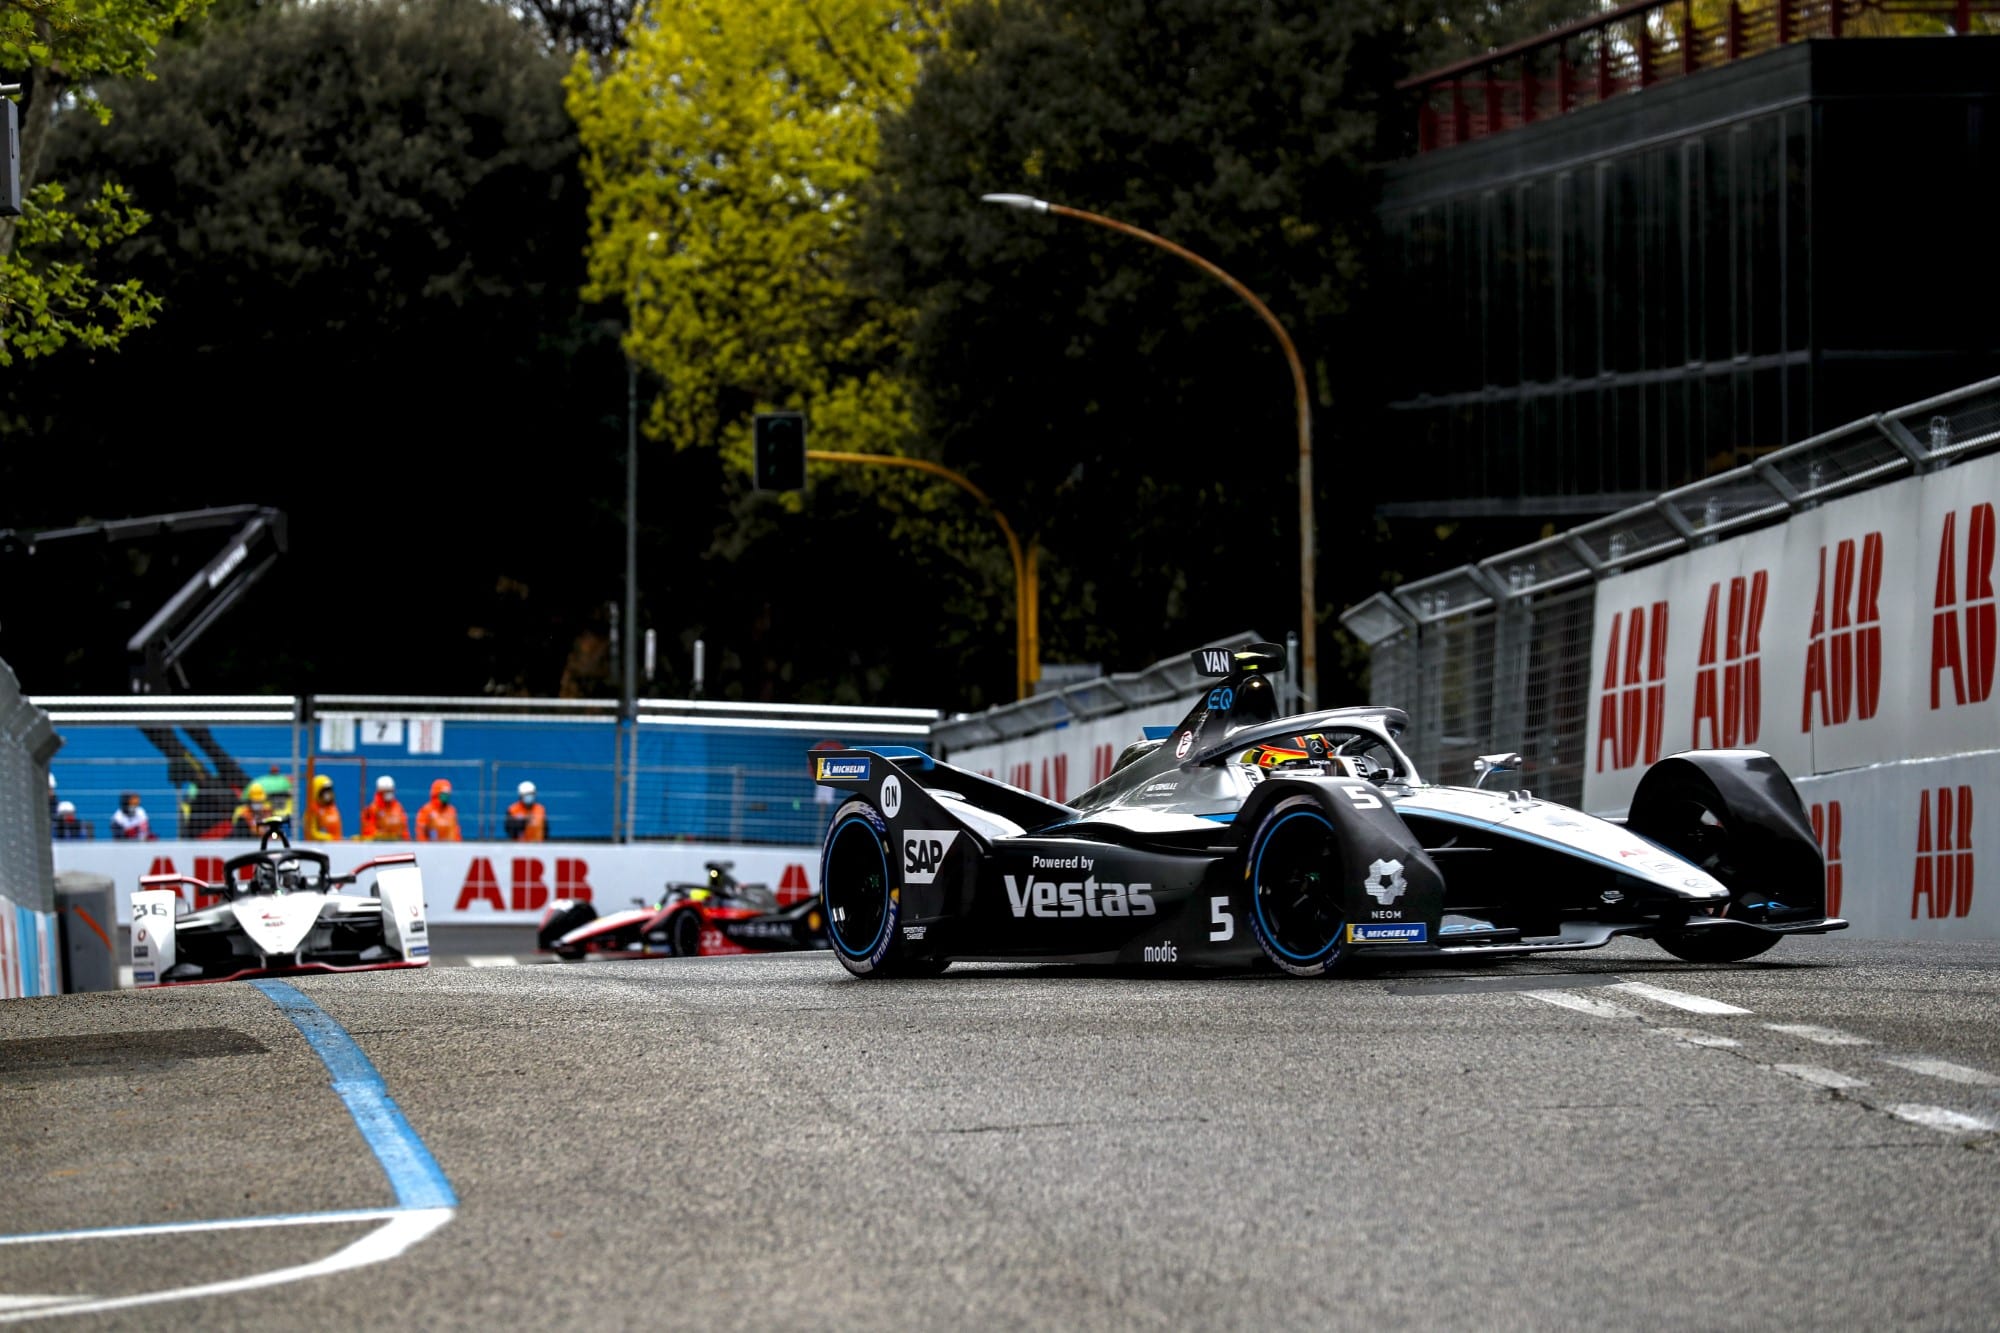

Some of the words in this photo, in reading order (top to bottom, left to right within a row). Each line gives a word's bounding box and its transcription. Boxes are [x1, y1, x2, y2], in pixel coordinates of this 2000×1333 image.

[1802, 531, 1883, 733] ABB
[1202, 651, 1230, 673] VAN
[1692, 569, 1769, 750] ABB
[1207, 687, 1233, 711] EQ
[1596, 600, 1669, 773] ABB
[832, 764, 866, 774] MICHELIN
[885, 785, 898, 808] ON
[1342, 785, 1383, 810] 5
[904, 838, 943, 874] SAP
[1032, 855, 1078, 869] Powered
[1080, 856, 1094, 871] by
[1911, 784, 1974, 920] ABB
[453, 856, 593, 912] ABB
[1003, 874, 1157, 918] Vestas
[1209, 895, 1235, 942] 5
[1371, 910, 1402, 919] NEOM
[1366, 929, 1419, 938] MICHELIN
[1144, 940, 1177, 962] modis
